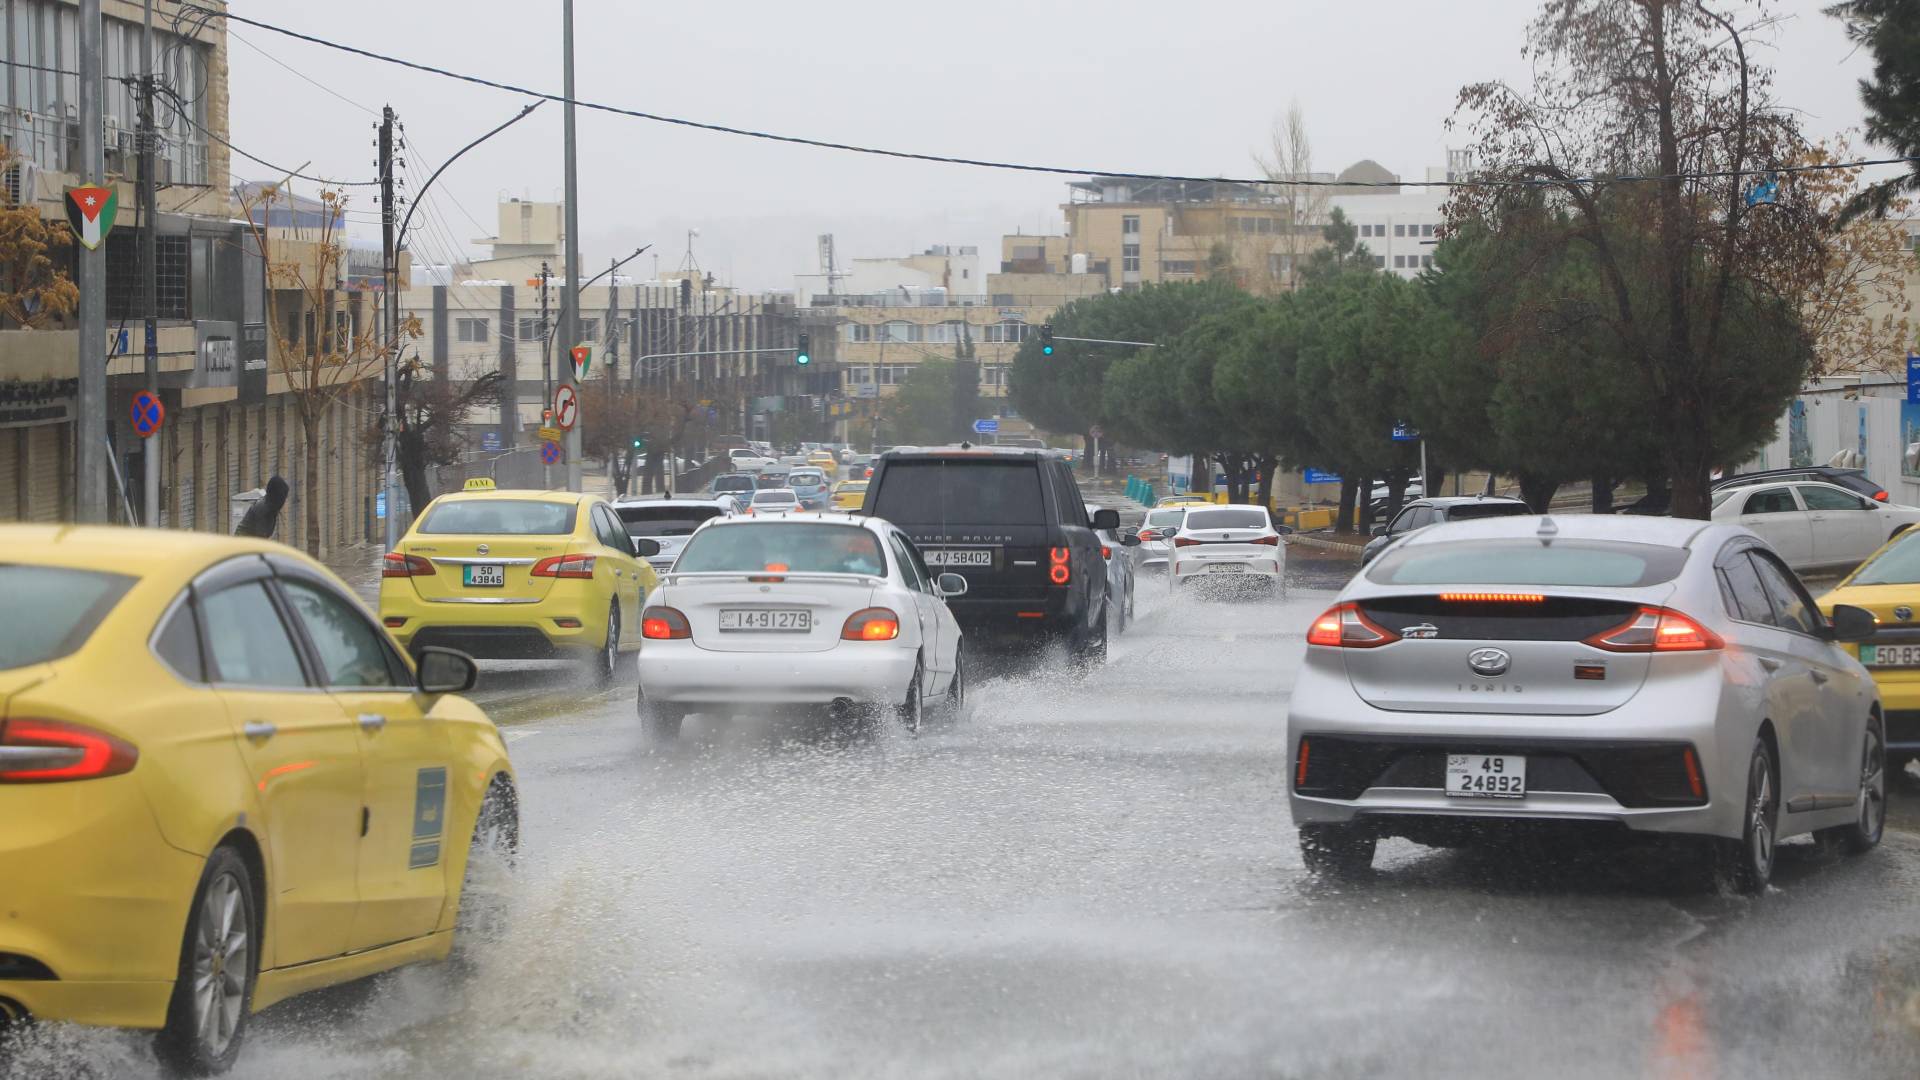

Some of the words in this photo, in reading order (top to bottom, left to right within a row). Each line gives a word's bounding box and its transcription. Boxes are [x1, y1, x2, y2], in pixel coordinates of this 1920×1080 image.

[469, 479, 488, 487] TAXI
[935, 552, 990, 564] 47-58402
[480, 566, 493, 575] 50
[471, 575, 502, 584] 43846
[738, 612, 808, 627] 14-91279
[1481, 758, 1504, 773] 49
[1461, 775, 1522, 792] 24892
